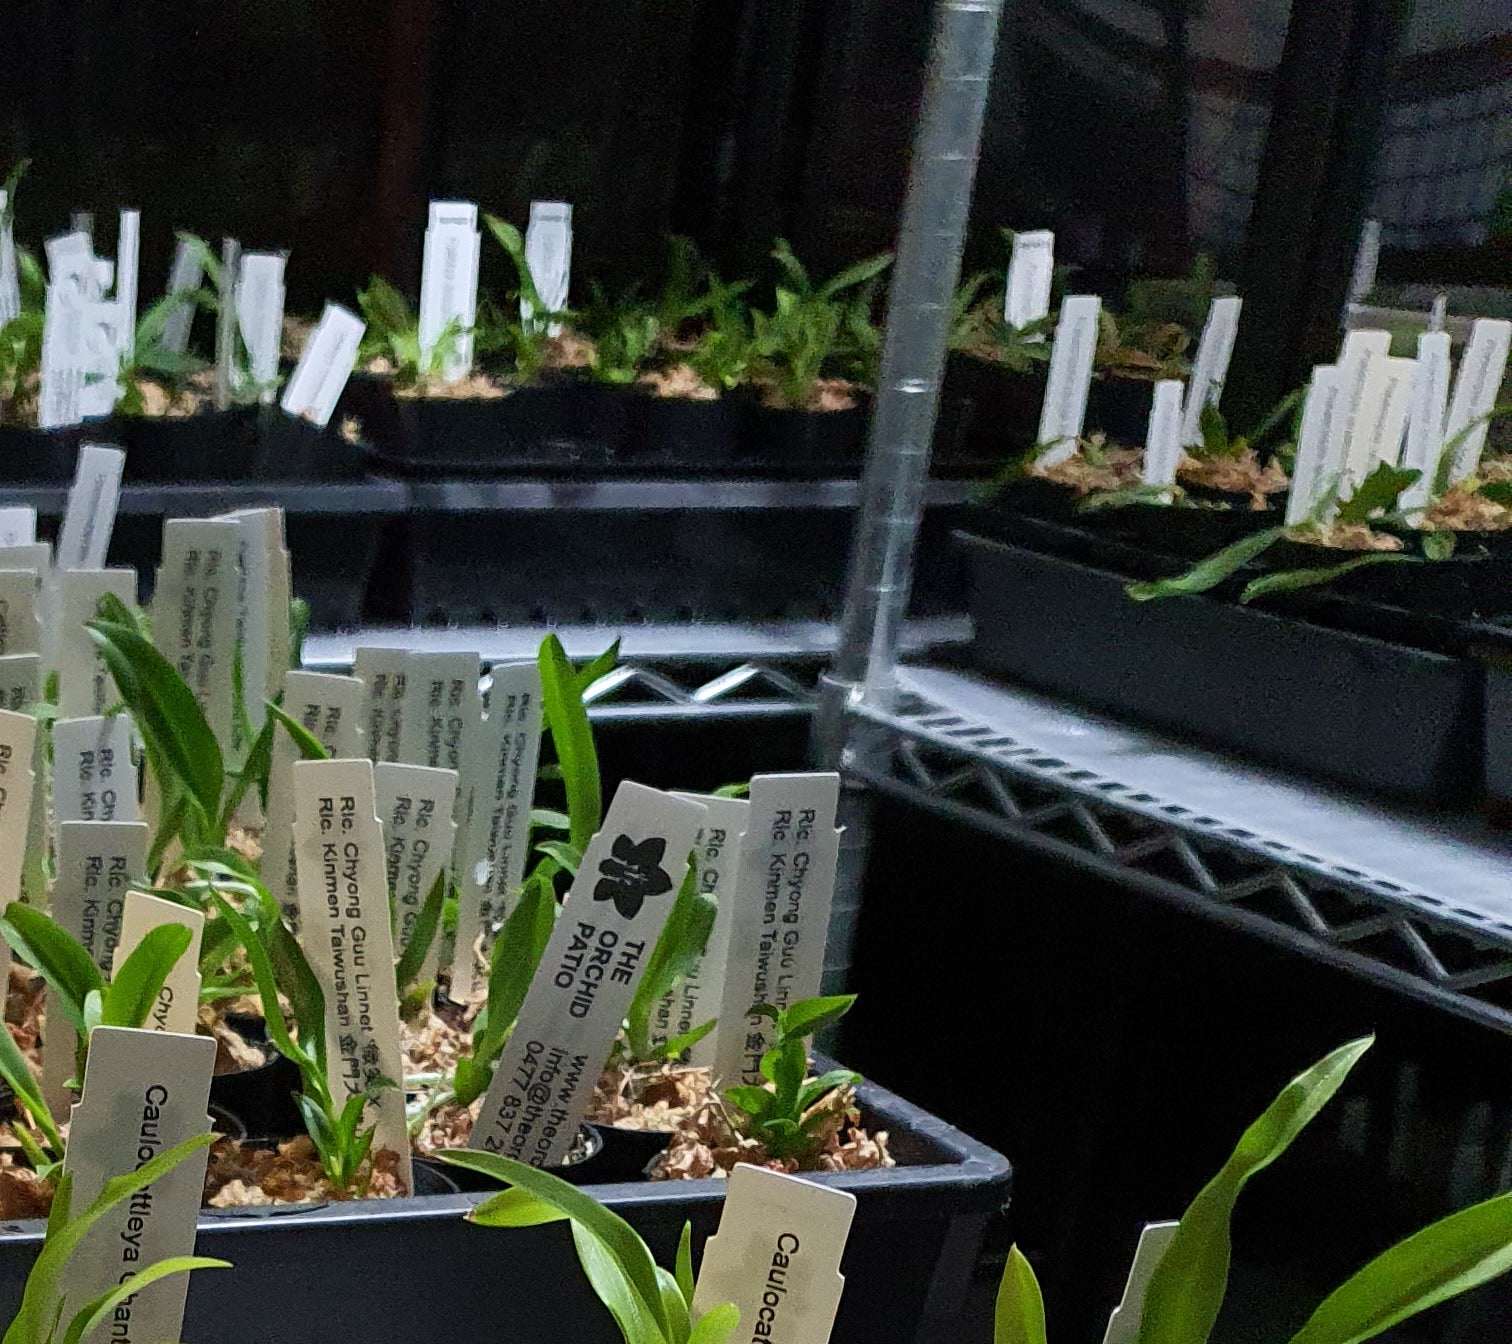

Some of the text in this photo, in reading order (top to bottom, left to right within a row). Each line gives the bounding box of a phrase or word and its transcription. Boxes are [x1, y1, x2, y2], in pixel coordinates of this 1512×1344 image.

[323, 842, 340, 918] Kinmen
[343, 846, 360, 918] Chyong
[763, 854, 786, 925] Kinmen
[783, 852, 809, 924] Chyong
[328, 924, 352, 1027] Taiwushan
[350, 926, 366, 965] Guu
[555, 920, 596, 990] PATIO
[569, 929, 619, 1019] ORCHID
[610, 937, 646, 986] THE
[751, 930, 778, 1026] Taiwushn
[354, 974, 372, 1032] Linnet
[495, 1041, 544, 1133] 0477 837
[120, 1084, 168, 1263] Caulottleya
